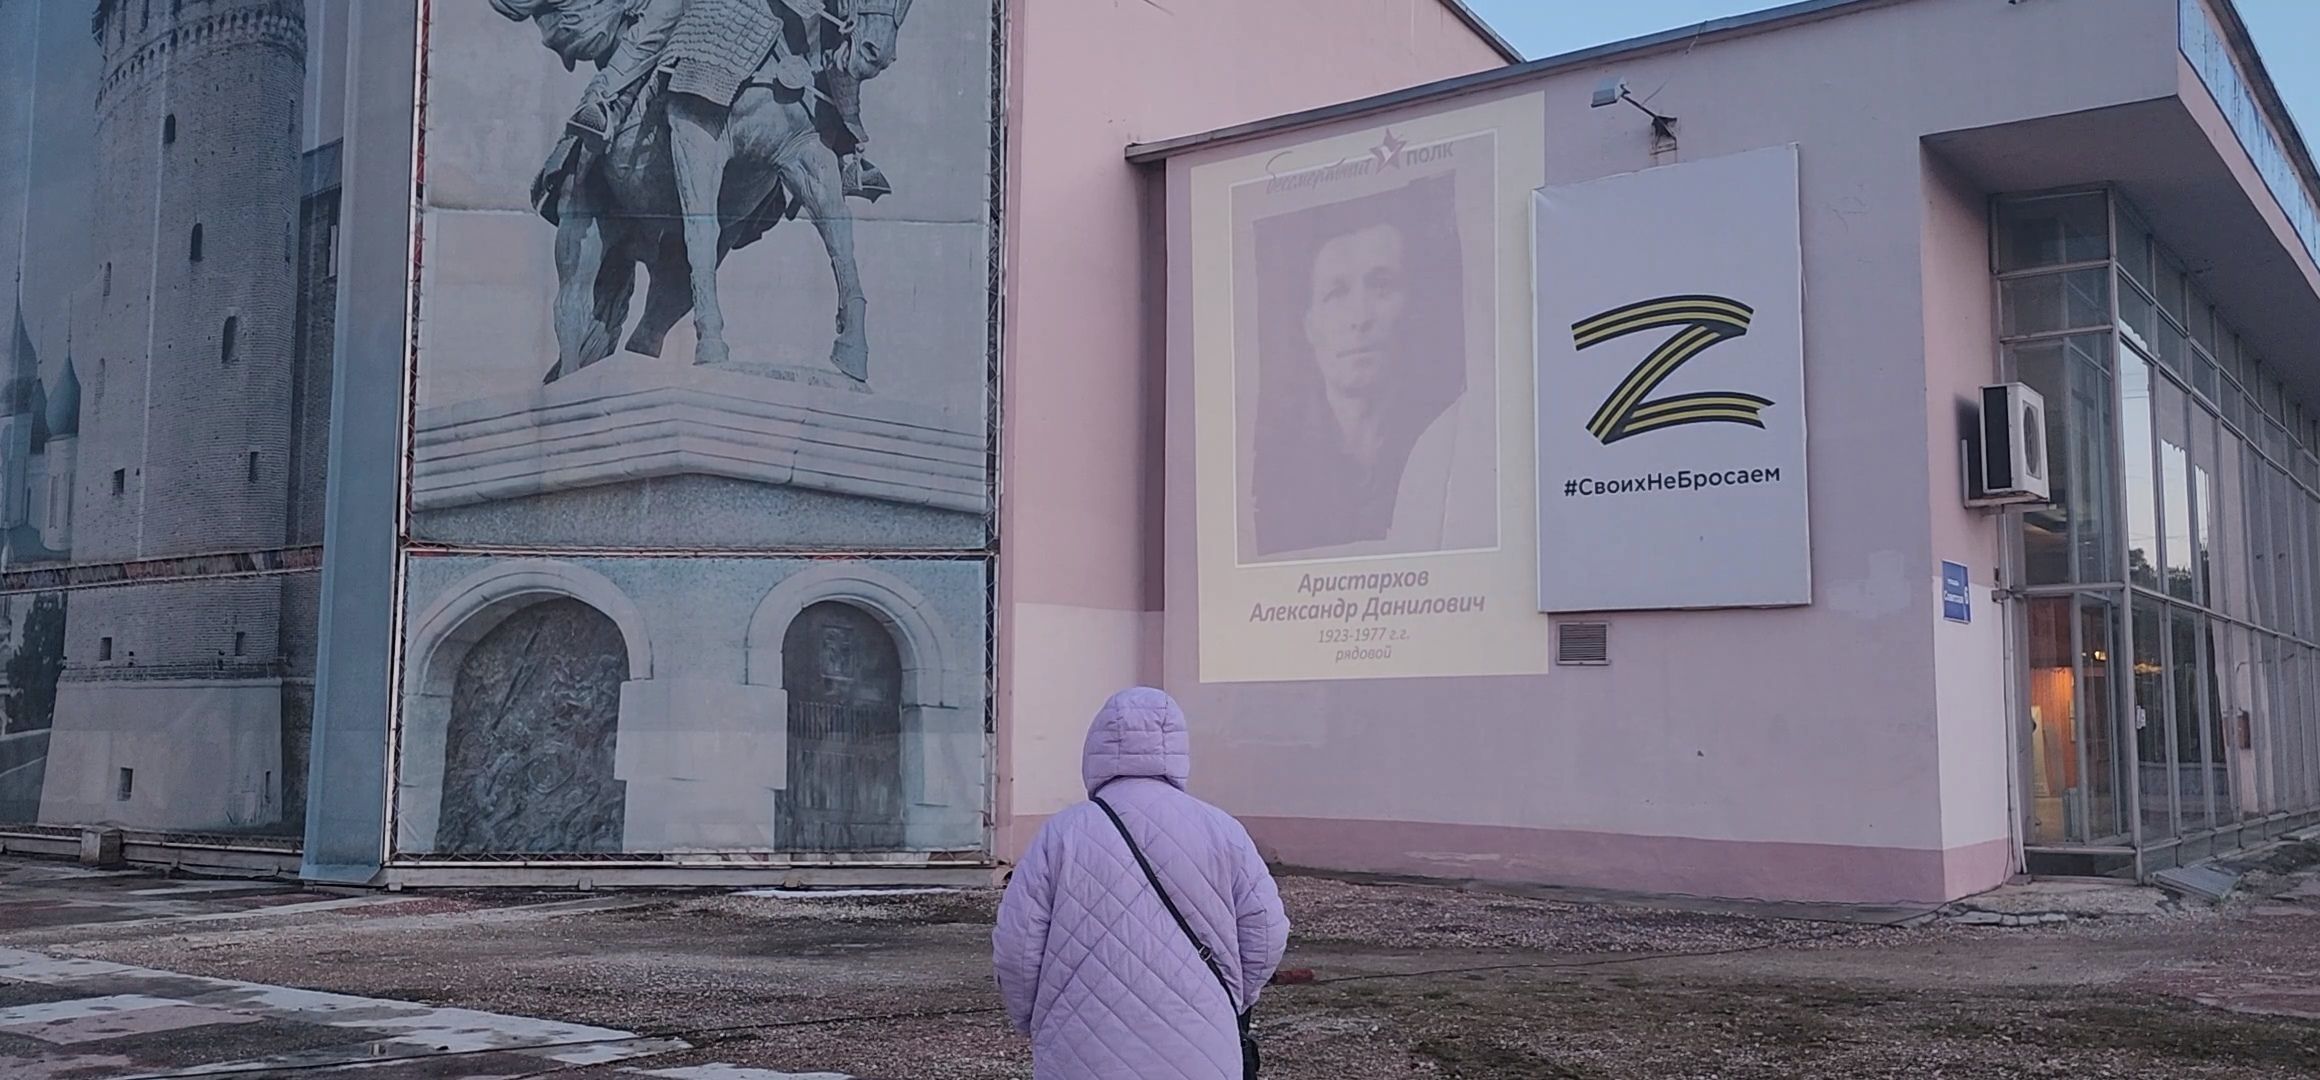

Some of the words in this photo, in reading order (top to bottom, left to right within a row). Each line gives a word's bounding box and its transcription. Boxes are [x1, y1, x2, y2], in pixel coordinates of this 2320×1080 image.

[1564, 467, 1780, 497] #СвоихНеБросаем
[1298, 570, 1429, 597] Аристархов
[1249, 598, 1358, 623] Александр
[1361, 595, 1486, 622] Данилович
[1318, 627, 1387, 644] 1923-1977
[1335, 645, 1392, 662] рядовой
